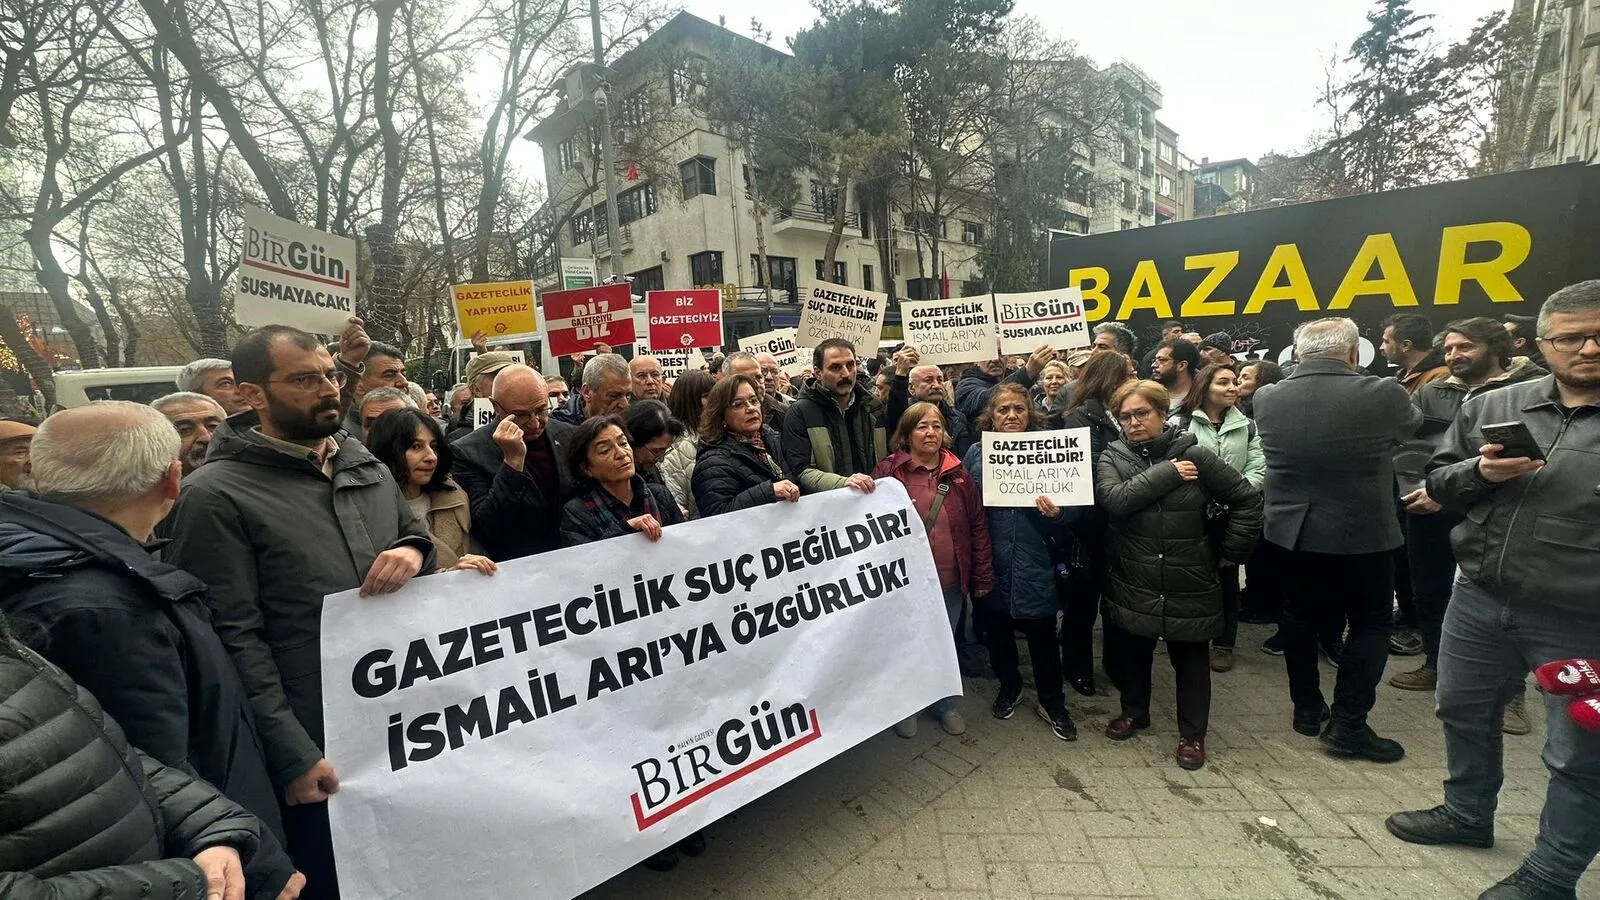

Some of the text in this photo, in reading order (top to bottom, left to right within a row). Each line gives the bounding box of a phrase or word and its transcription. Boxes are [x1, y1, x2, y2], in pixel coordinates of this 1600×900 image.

[1069, 221, 1532, 322] BAZAAR
[240, 276, 351, 312] SUSMAYACAK!
[456, 287, 531, 301] GAZETECİLİK
[675, 296, 694, 307] BİZ
[813, 288, 877, 310] GAZETECİLİK
[465, 304, 528, 317] YAPIYORUZ
[807, 300, 878, 323] SUÇ DEĞİLDİR!
[911, 303, 984, 319] GAZETECİLİK
[650, 312, 719, 326] GAZETECİYİZ
[806, 313, 837, 329] İSMAİL
[908, 315, 989, 332] SUÇ DEĞİLDİR!
[913, 328, 986, 343] İSMAİL ARI'YA
[1003, 322, 1083, 339] SUSMAYACAK!
[920, 341, 982, 356] ÖZGÜRLÜK!
[993, 436, 1078, 451] GAZETECİLİK
[989, 450, 1084, 466] SUÇ DEĞİLDİR!
[993, 467, 1080, 480] İSMAİL ARI'YA
[1000, 481, 1074, 494] ÖZGÜRLÜK!
[352, 509, 911, 698] GAZETECİLİK SUÇ DEĞİLDİR!
[388, 558, 910, 772] İSMAİL ARI'YA ÖZGÜRLÜK!
